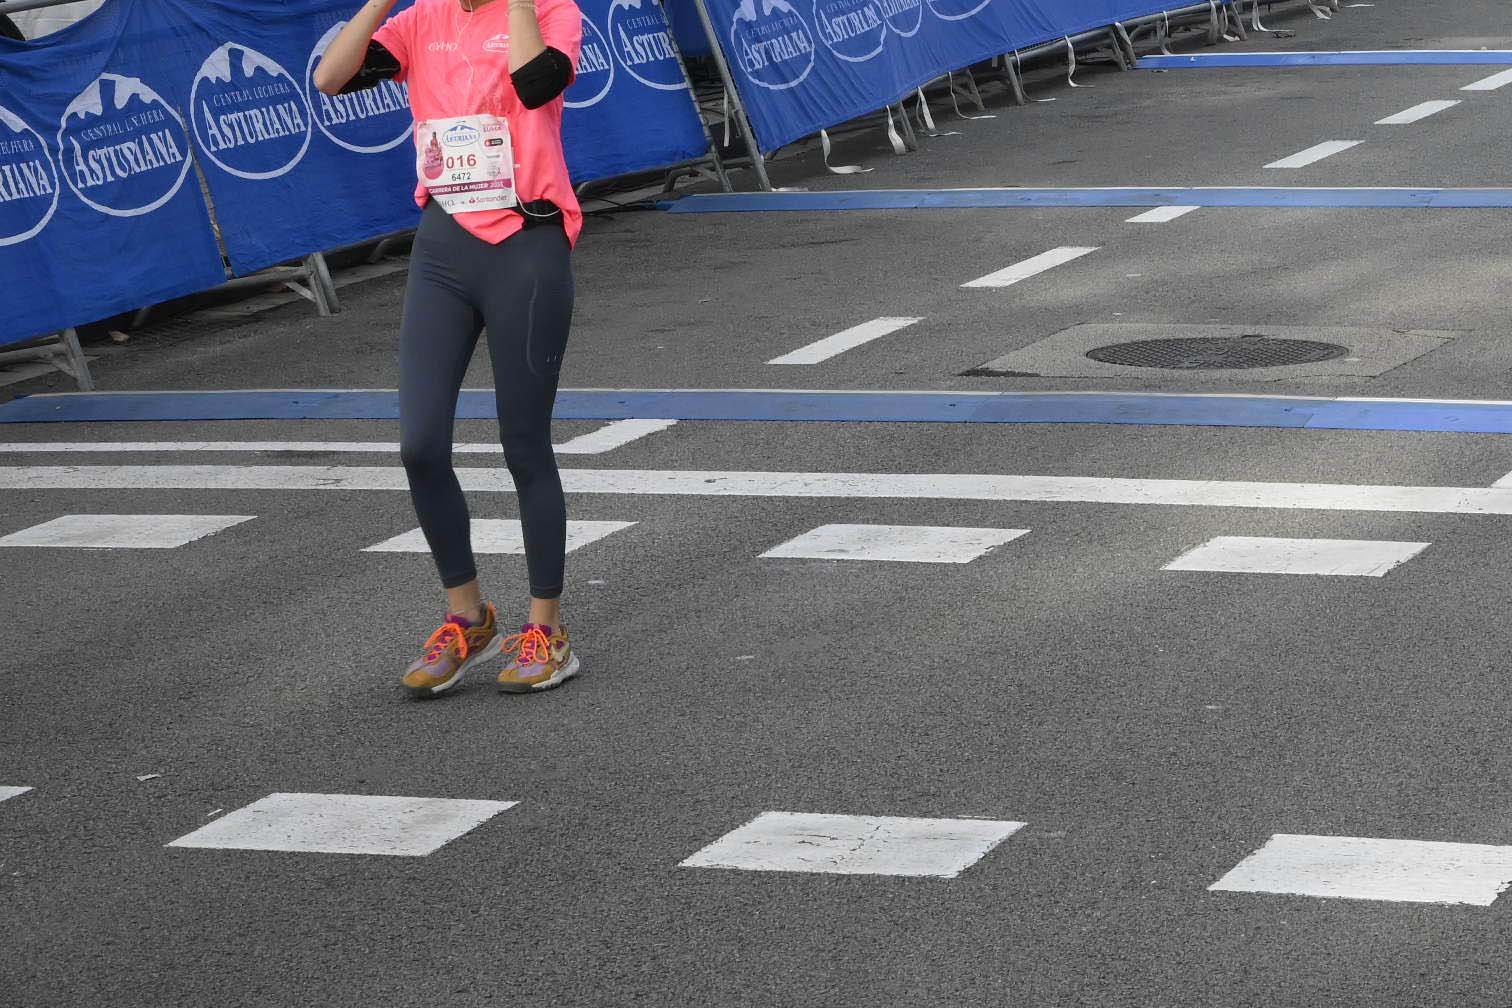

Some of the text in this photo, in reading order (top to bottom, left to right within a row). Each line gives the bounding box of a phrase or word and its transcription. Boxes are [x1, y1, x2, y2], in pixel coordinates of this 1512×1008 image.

[626, 15, 660, 29] CENTRAL
[213, 82, 290, 107] CENTRAL LECHERA
[81, 123, 120, 141] CENTRAL
[203, 99, 306, 152] ASTURIANA
[70, 128, 183, 189] ASTURIANA
[446, 154, 477, 169] 016
[451, 172, 472, 182] 6472
